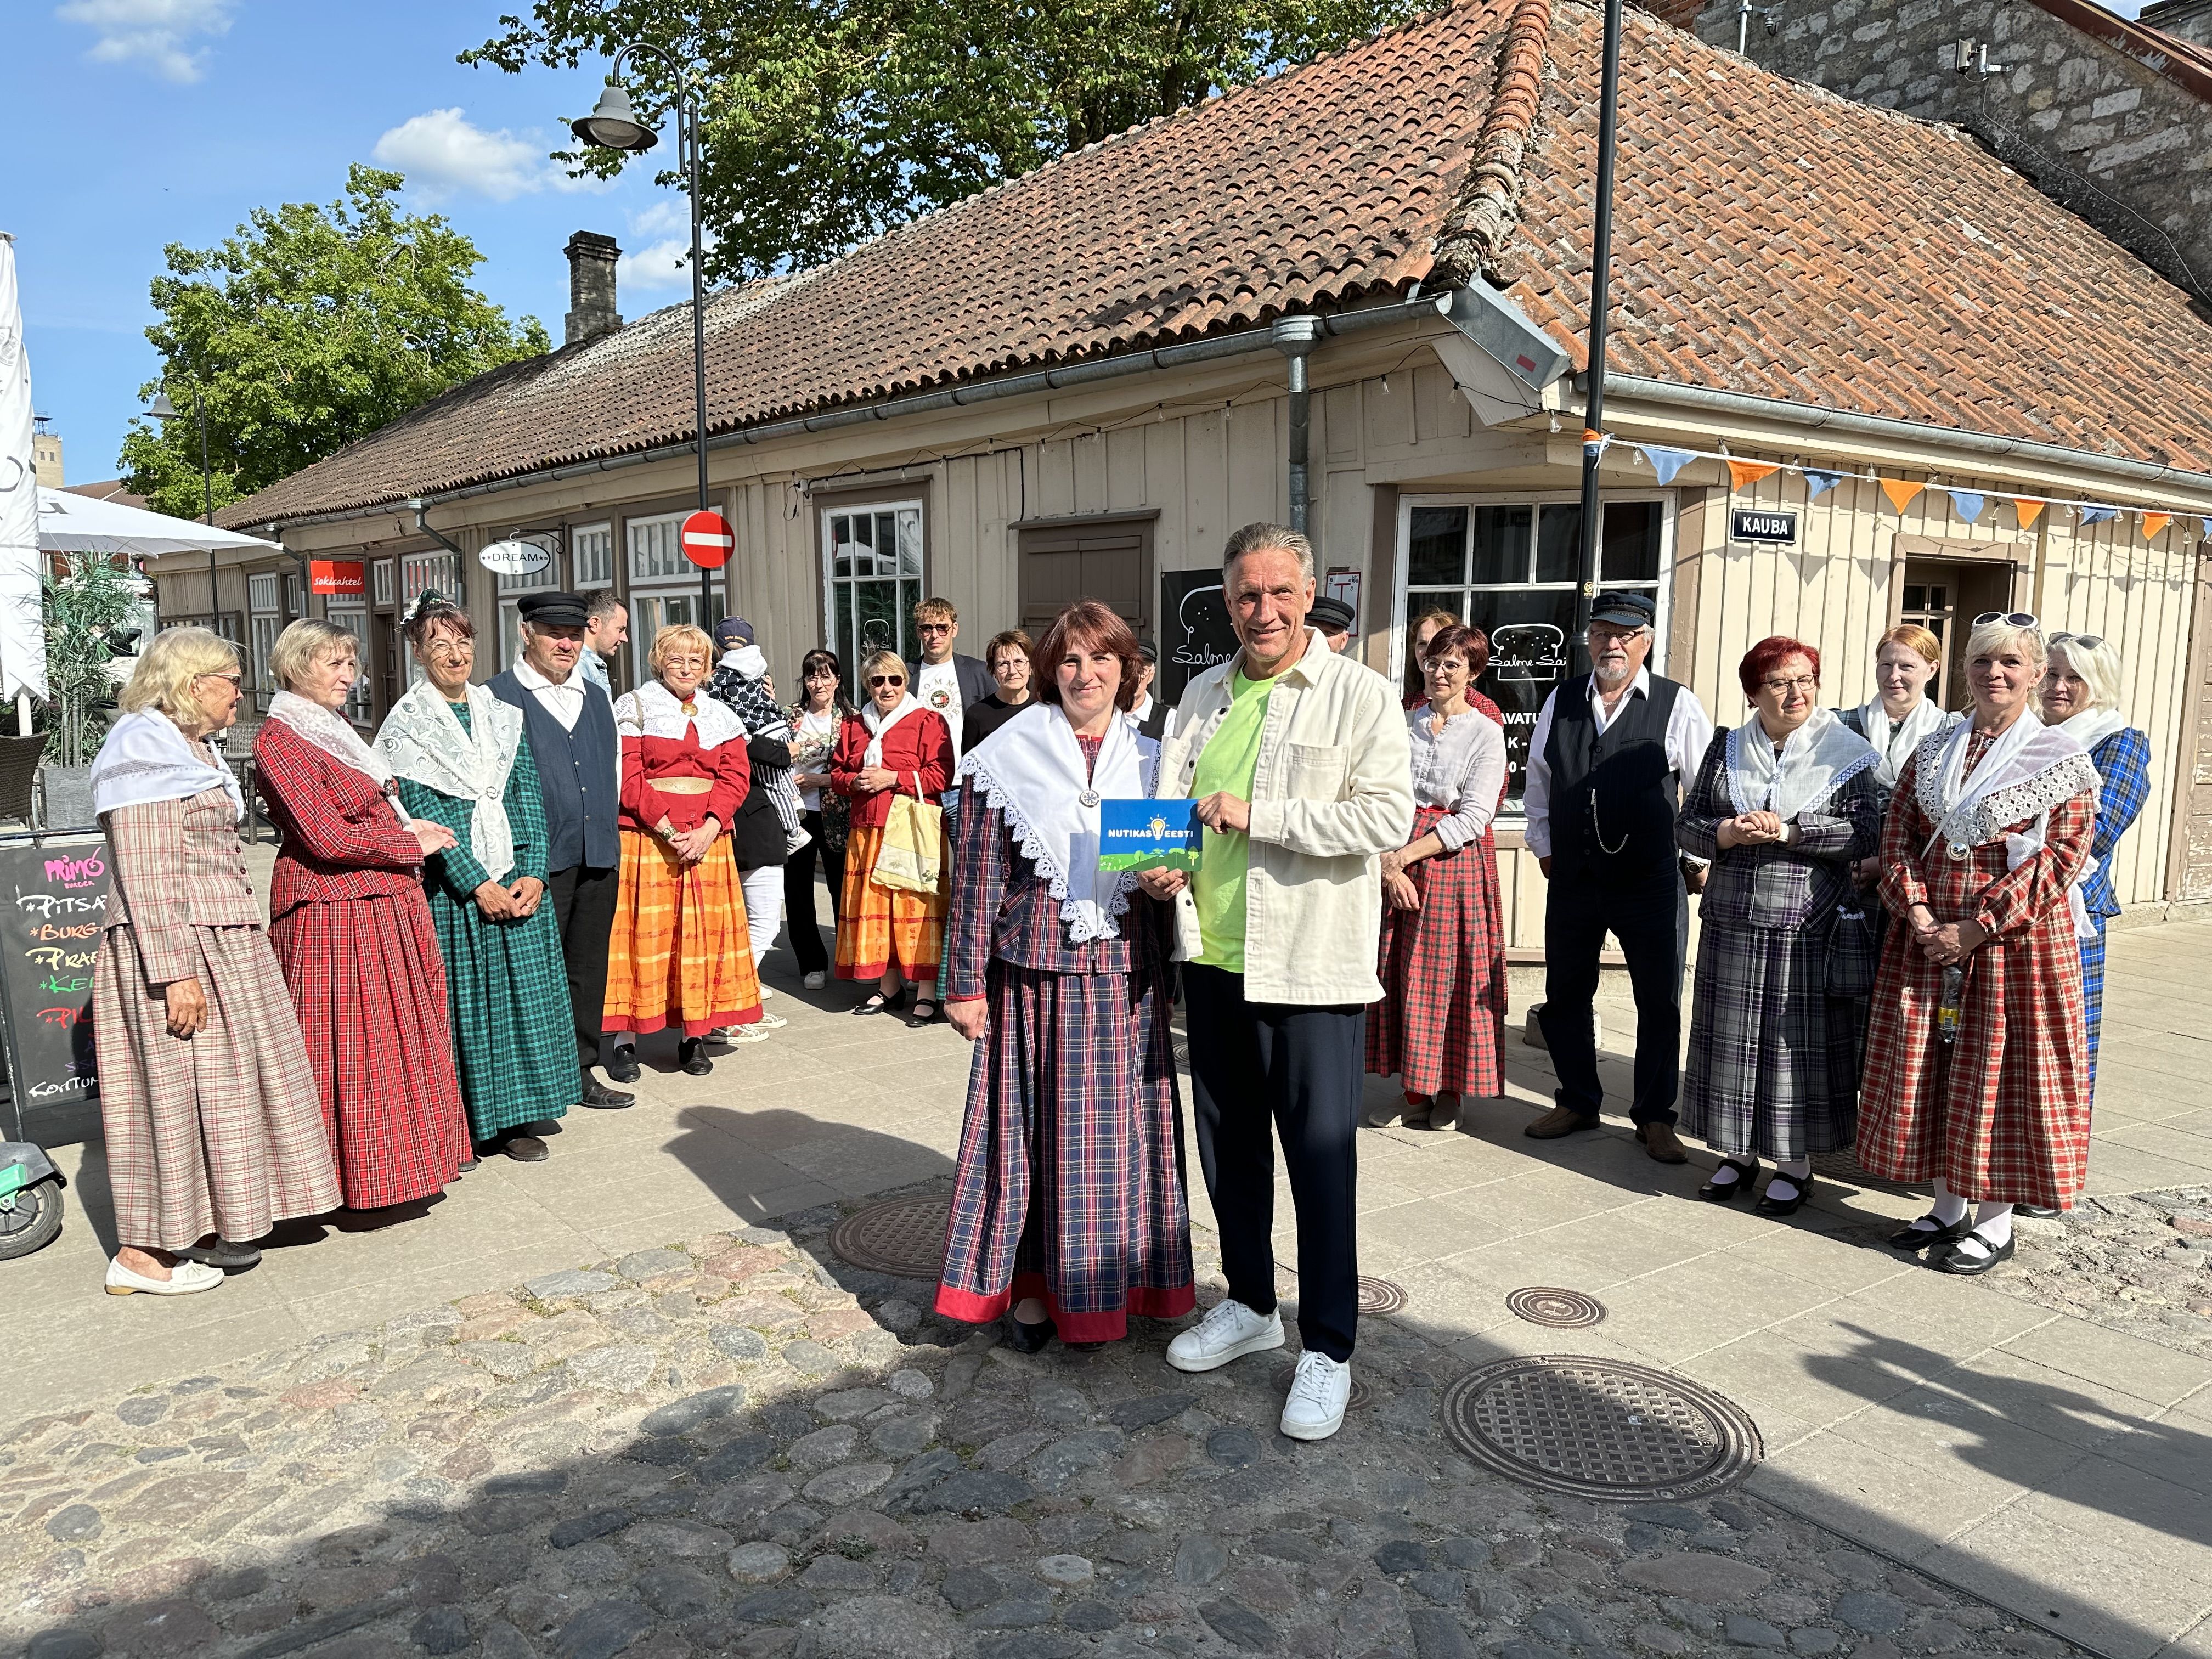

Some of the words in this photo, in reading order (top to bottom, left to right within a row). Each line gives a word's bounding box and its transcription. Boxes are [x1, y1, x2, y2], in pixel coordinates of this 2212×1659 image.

[1742, 516, 1788, 535] KAUBA
[492, 553, 538, 562] DREAM
[313, 575, 363, 586] sokisahtel
[1171, 642, 1231, 665] Salme
[1486, 654, 1534, 667] Salme
[1536, 654, 1567, 667] Sai
[1108, 830, 1152, 838] NUTIKAS
[63, 880, 95, 889] BURGER
